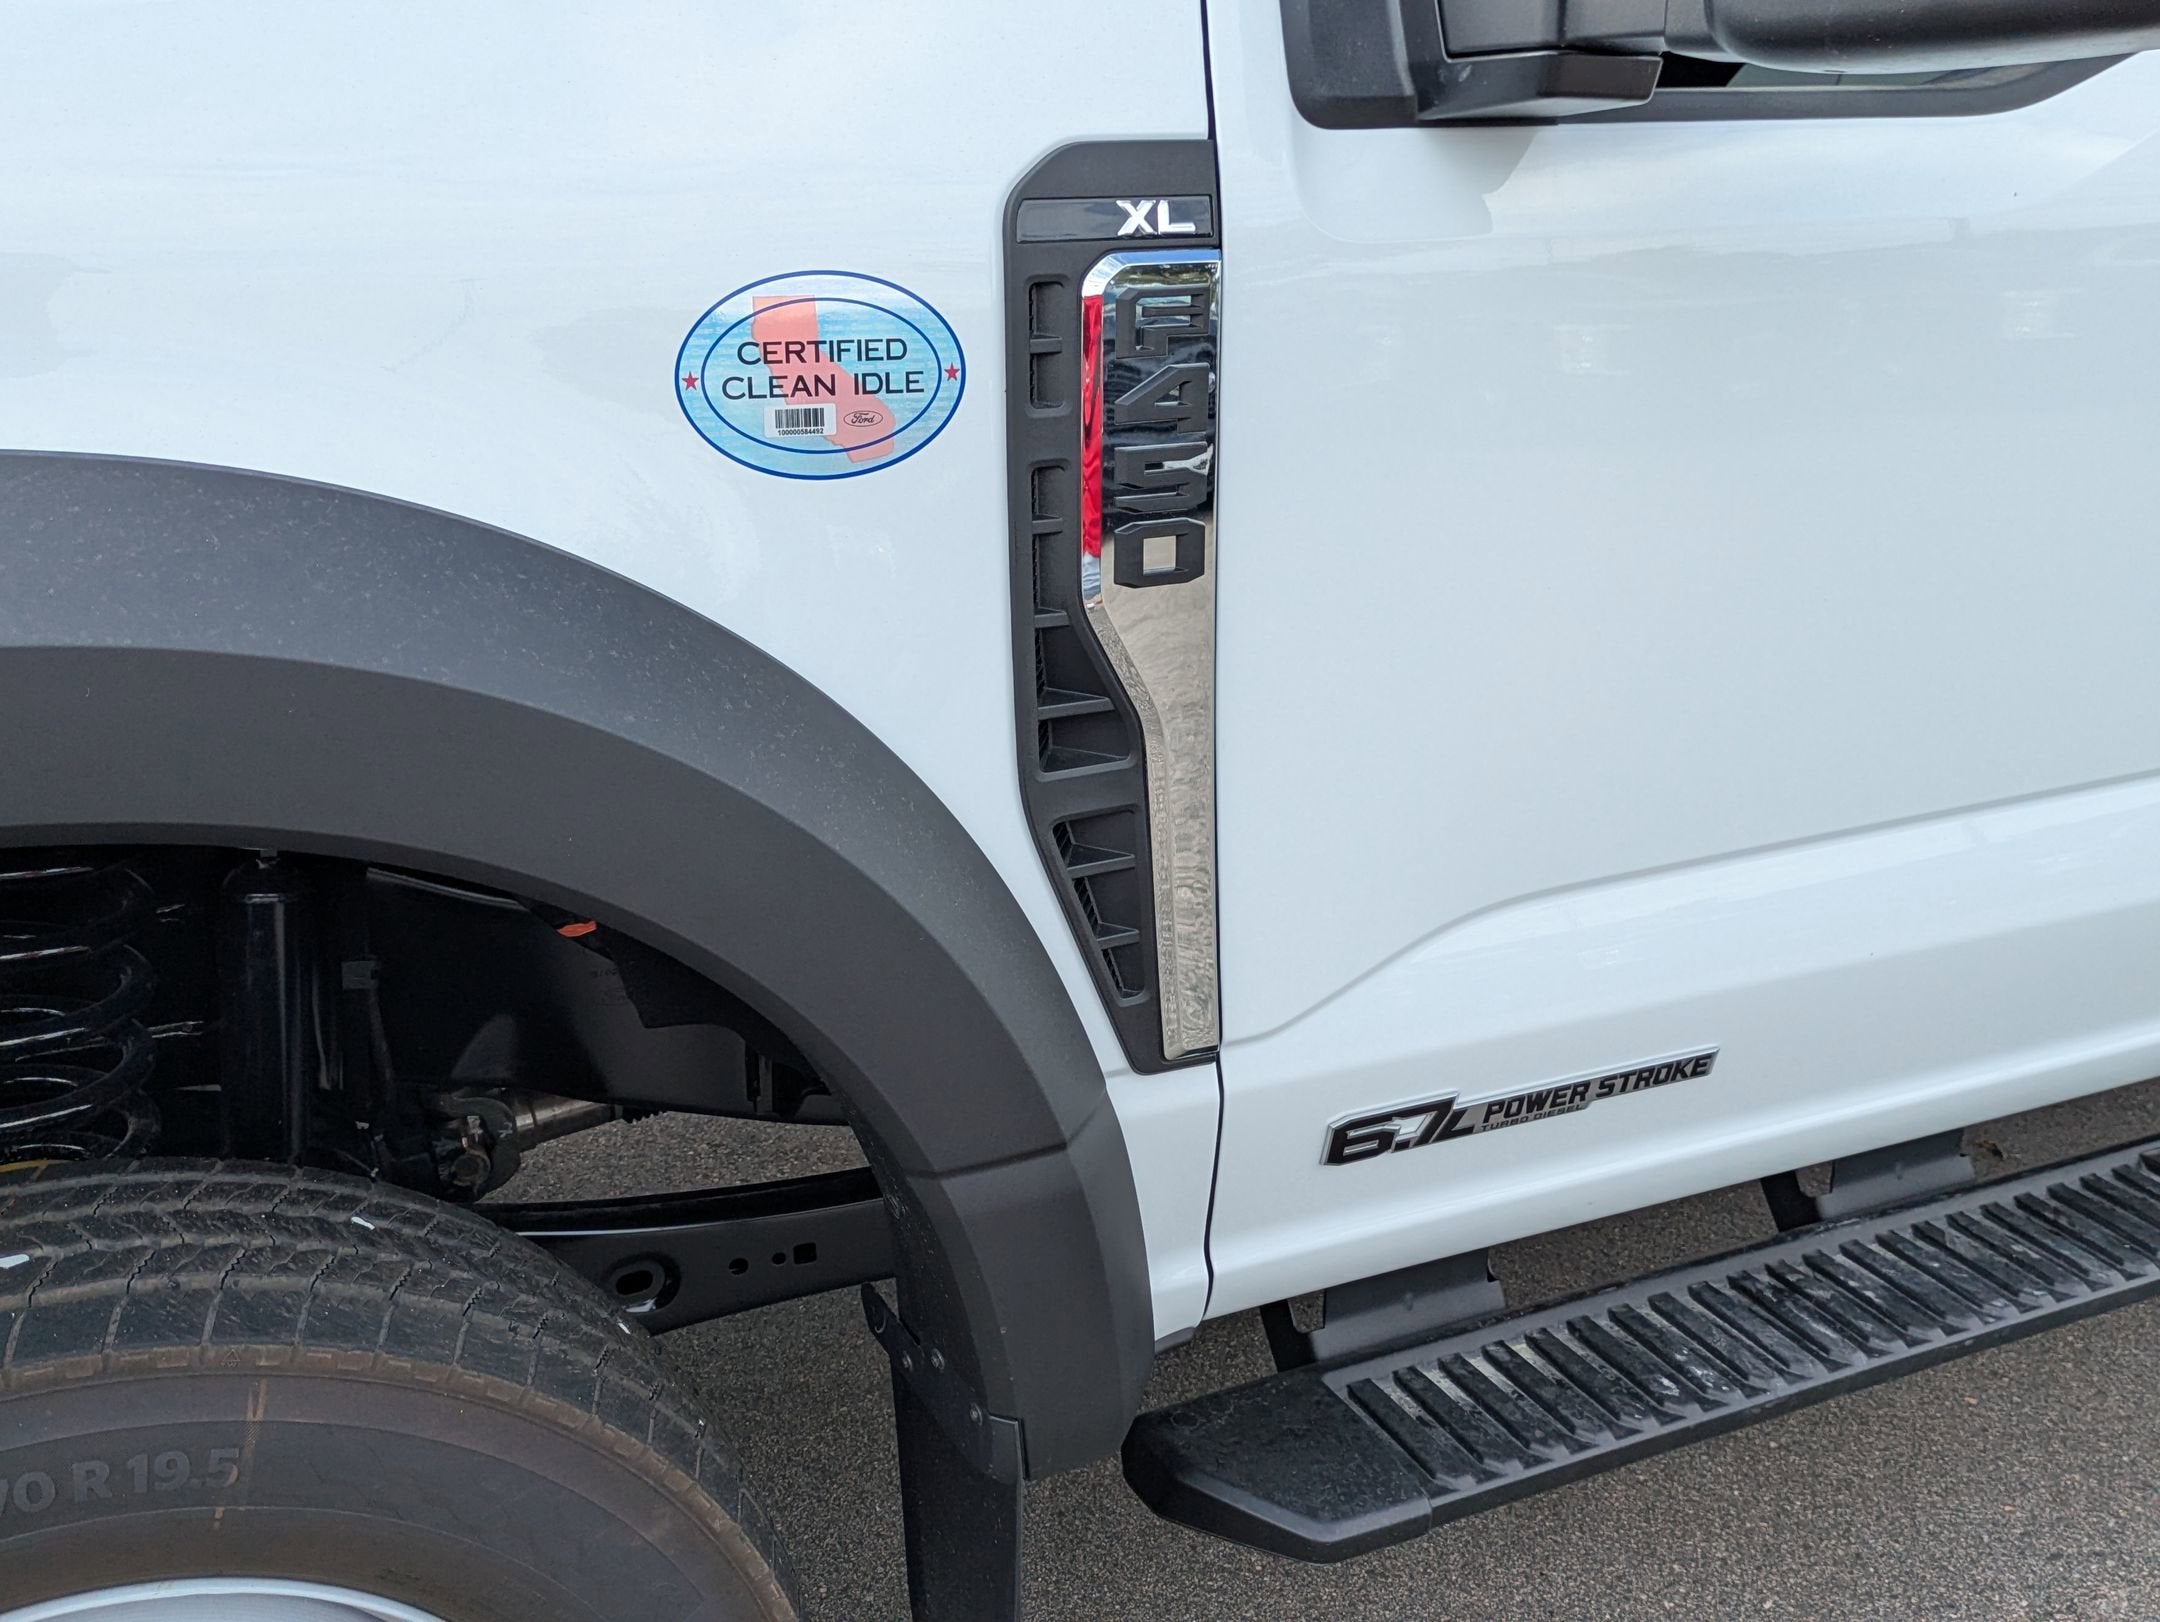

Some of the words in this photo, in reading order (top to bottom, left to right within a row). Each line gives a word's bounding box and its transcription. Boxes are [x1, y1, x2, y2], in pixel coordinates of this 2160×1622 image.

[1115, 200, 1196, 236] XL
[736, 338, 908, 366] CERTIFIED
[721, 373, 836, 400] CLEAN
[853, 371, 925, 395] IDLE
[851, 413, 876, 424] Ford
[1114, 285, 1210, 589] F450
[1324, 1099, 1476, 1166] 6.7L
[1482, 1080, 1592, 1124] POWER
[1596, 1053, 1714, 1098] STROKE
[1480, 1115, 1530, 1132] TURBO
[1533, 1104, 1586, 1120] DIESEL
[71, 1459, 113, 1501] R
[126, 1447, 240, 1494] 19.5
